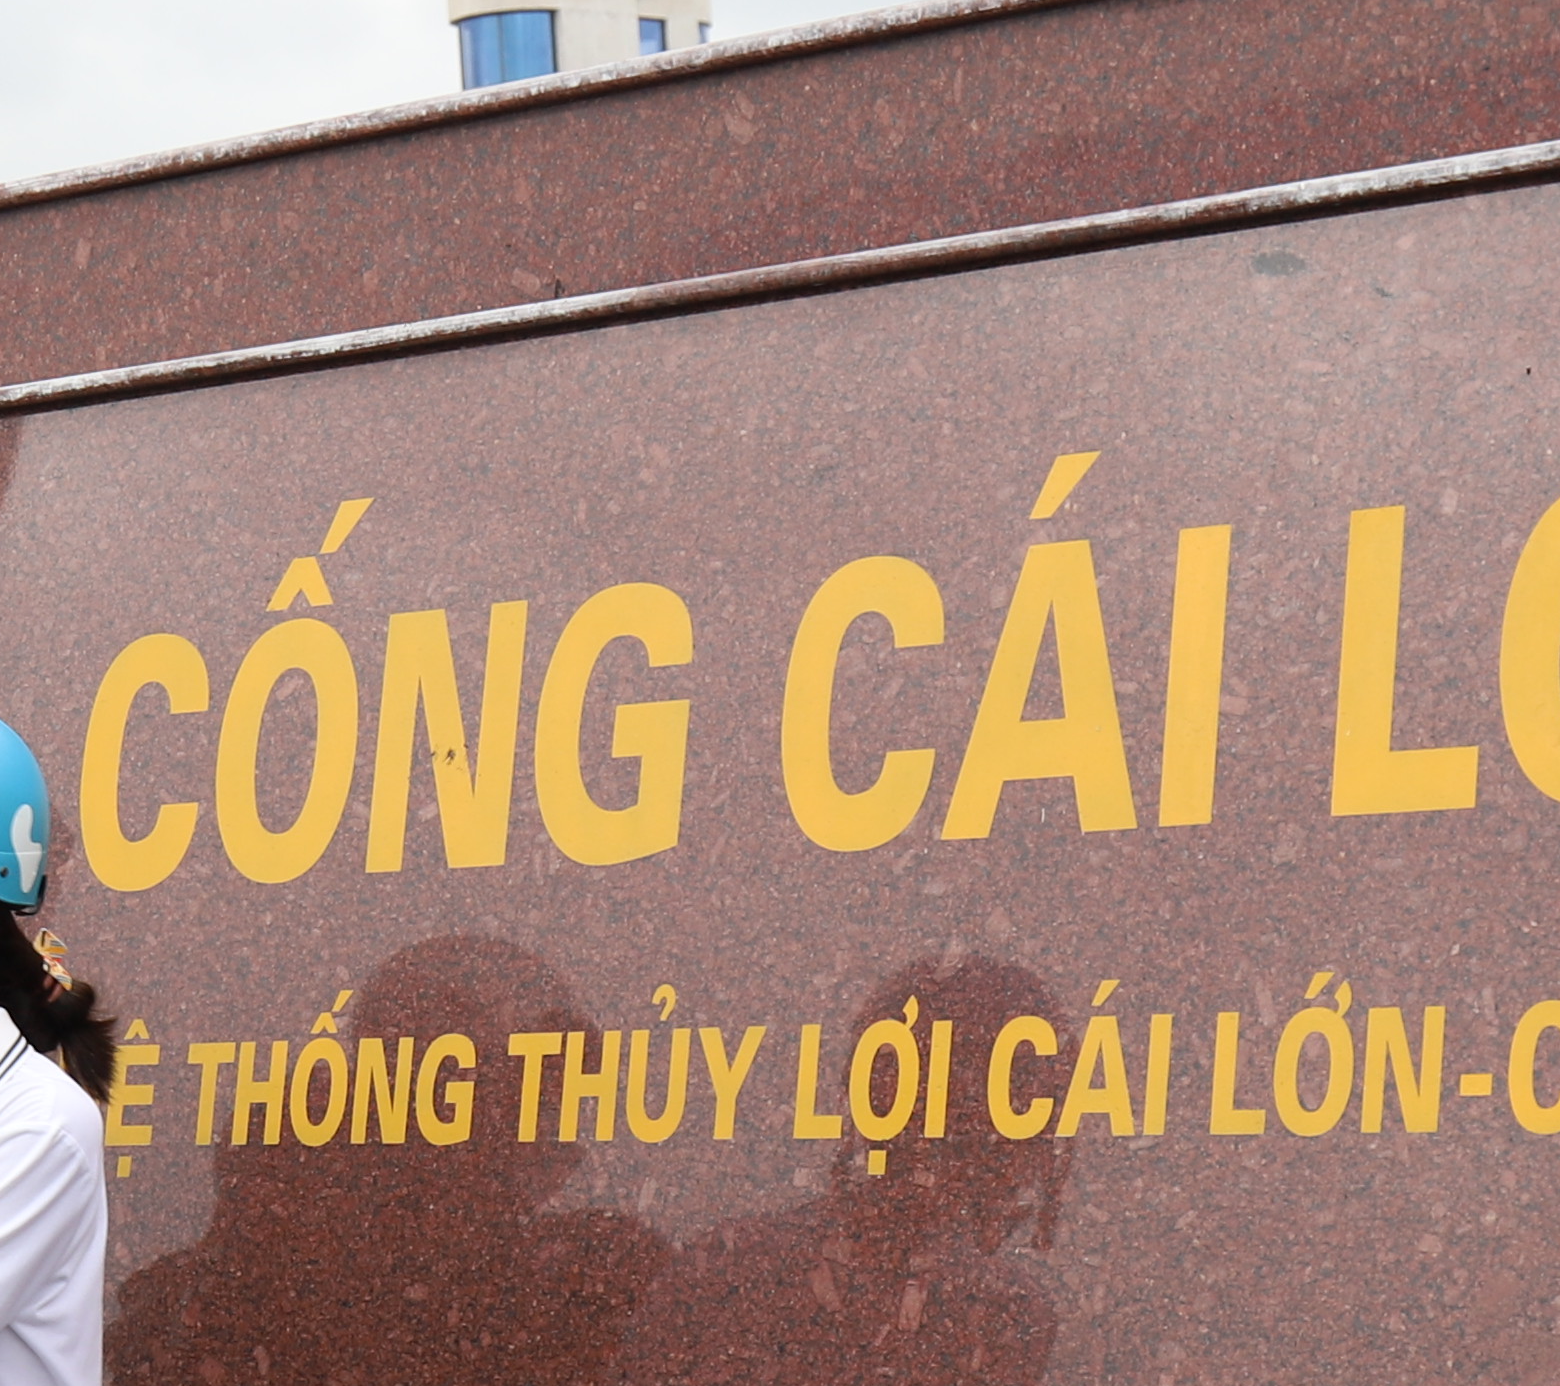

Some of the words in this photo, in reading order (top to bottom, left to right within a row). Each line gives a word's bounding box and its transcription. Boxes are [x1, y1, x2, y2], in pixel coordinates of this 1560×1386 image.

[80, 499, 695, 892] CỐNG
[782, 453, 1232, 852] CÁI
[100, 1018, 161, 1178] Ệ
[187, 988, 477, 1147] THỐNG
[507, 984, 767, 1143] THỦY
[792, 996, 953, 1176] LỢI
[987, 979, 1174, 1141] CÁI
